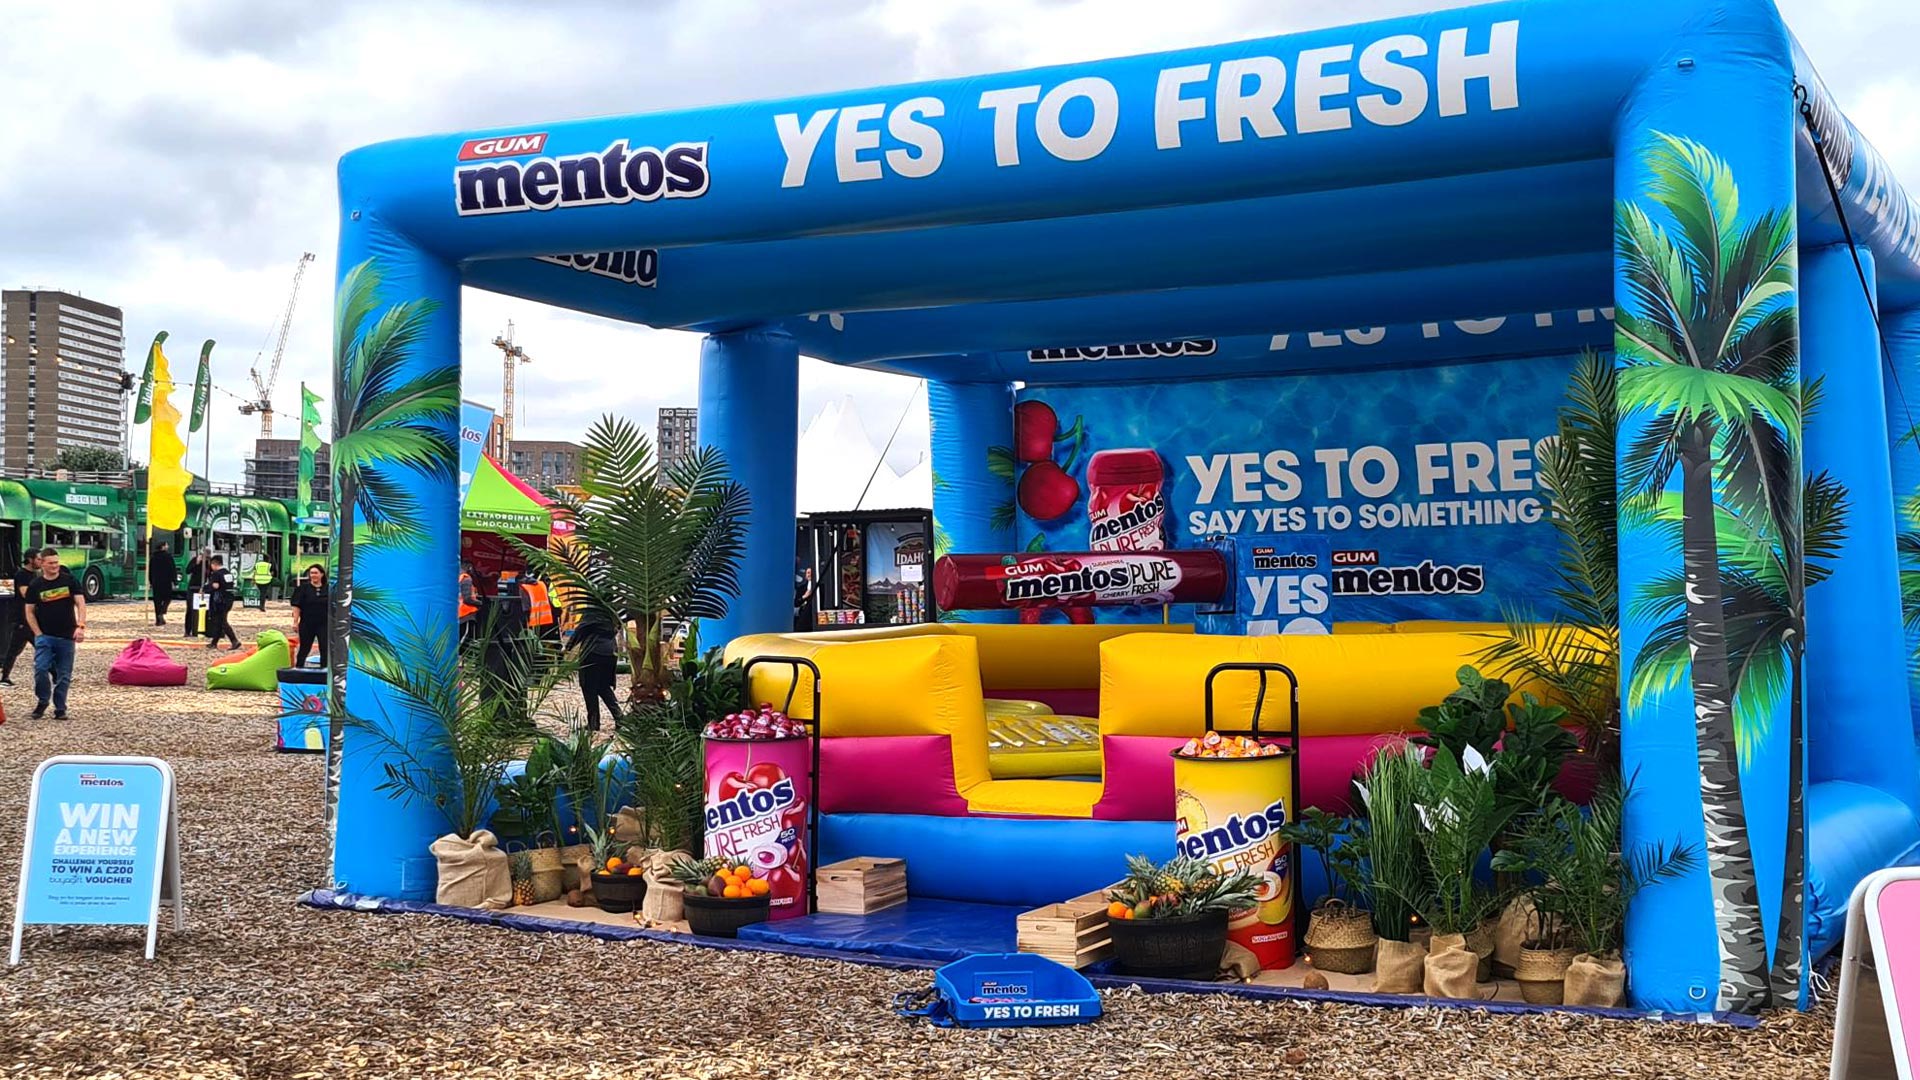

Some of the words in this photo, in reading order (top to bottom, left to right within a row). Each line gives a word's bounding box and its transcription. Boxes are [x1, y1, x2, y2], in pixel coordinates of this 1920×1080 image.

[774, 96, 945, 188] YES
[979, 76, 1119, 167] TO
[1154, 20, 1520, 150] FRESH
[473, 135, 543, 155] GUM
[456, 141, 708, 214] mentos
[461, 426, 483, 443] tos
[1185, 449, 1303, 505] YES
[1314, 445, 1400, 499] TO
[1415, 435, 1585, 495] FRES
[466, 510, 541, 522] EXTRAORDINARY
[476, 520, 532, 530] CHOCOLATE
[1091, 493, 1164, 542] mentos
[1188, 510, 1246, 536] SAY
[1252, 506, 1307, 532] YES
[1313, 505, 1352, 530] TO
[1359, 497, 1544, 530] SOMETHING
[896, 551, 924, 565] IDAH
[1253, 553, 1317, 569] mentos
[1333, 551, 1377, 564] GUM
[1005, 563, 1045, 576] GUM
[1130, 559, 1177, 584] PURE
[1332, 560, 1484, 596] mentos
[1008, 565, 1130, 600] mentos
[1131, 582, 1160, 595] FRESH
[1246, 573, 1330, 616] YES
[80, 778, 124, 786] mentos
[703, 780, 794, 832] entos
[60, 802, 140, 829] WIN
[742, 814, 780, 840] FRESH
[55, 828, 73, 845] A
[79, 829, 138, 846] NEW
[54, 844, 137, 856] EXPERIENCE
[1233, 840, 1275, 869] FRESH
[52, 865, 66, 873] TO
[69, 865, 93, 874] WIN
[95, 866, 103, 874] A
[106, 866, 134, 874] £200
[86, 876, 133, 884] VOUCHER
[982, 984, 1027, 995] mentos
[984, 1006, 1010, 1019] YES
[1015, 1006, 1032, 1018] TO
[1035, 1004, 1080, 1018] FRESH
